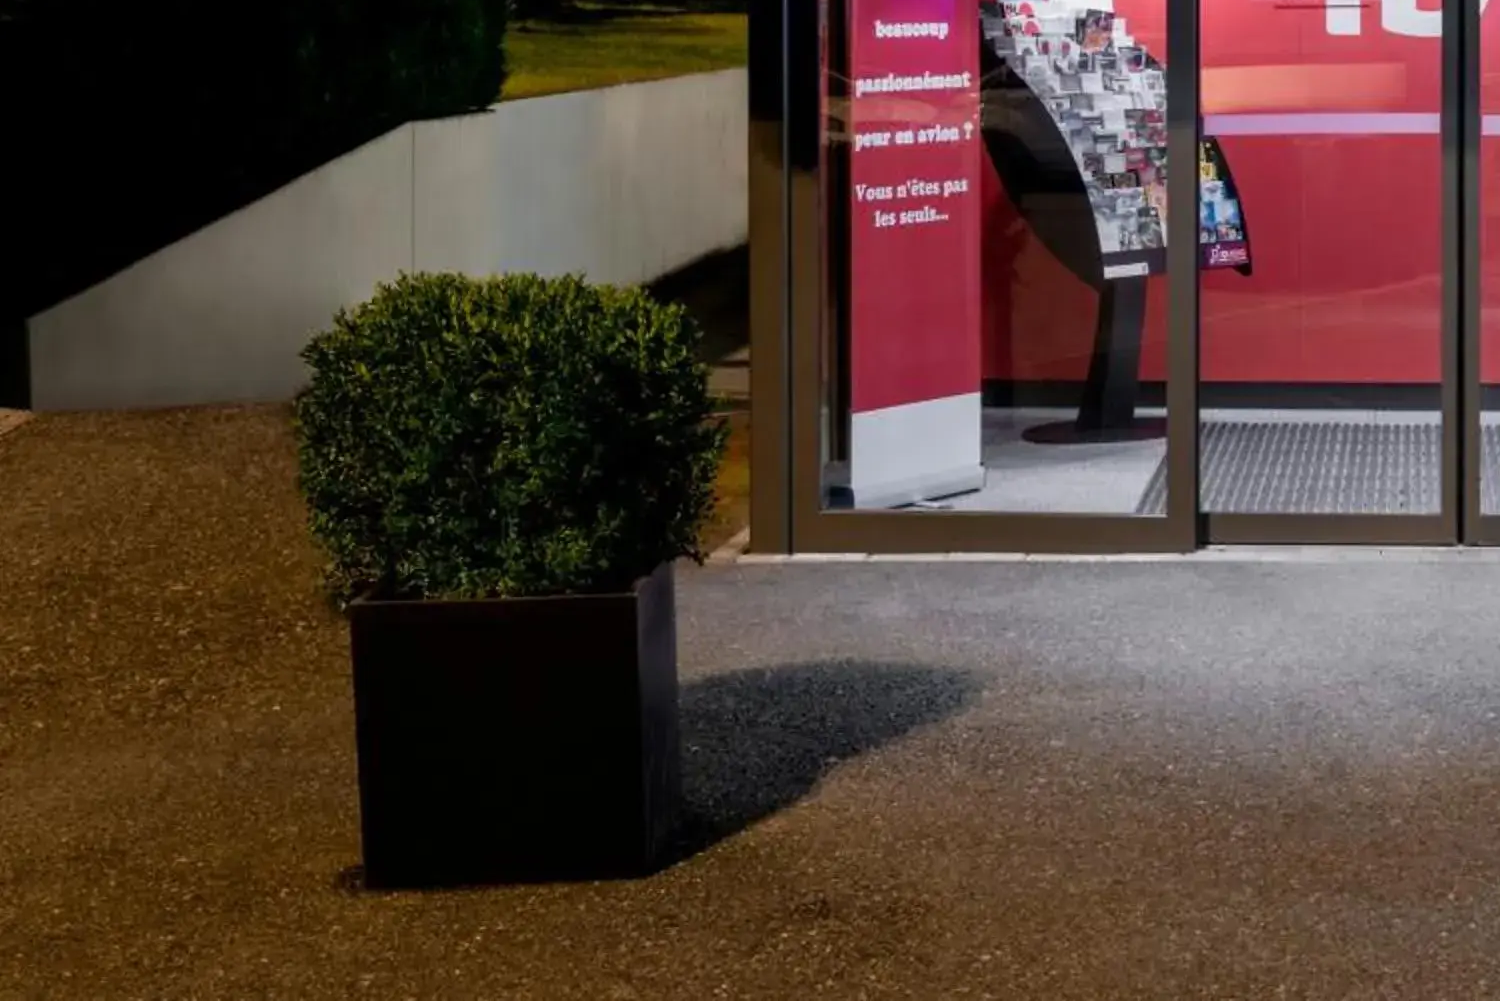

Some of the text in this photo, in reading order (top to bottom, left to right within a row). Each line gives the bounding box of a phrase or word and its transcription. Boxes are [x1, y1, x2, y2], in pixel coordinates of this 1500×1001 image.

[856, 183, 893, 202] Vous
[944, 178, 969, 198] pas
[874, 209, 896, 227] les
